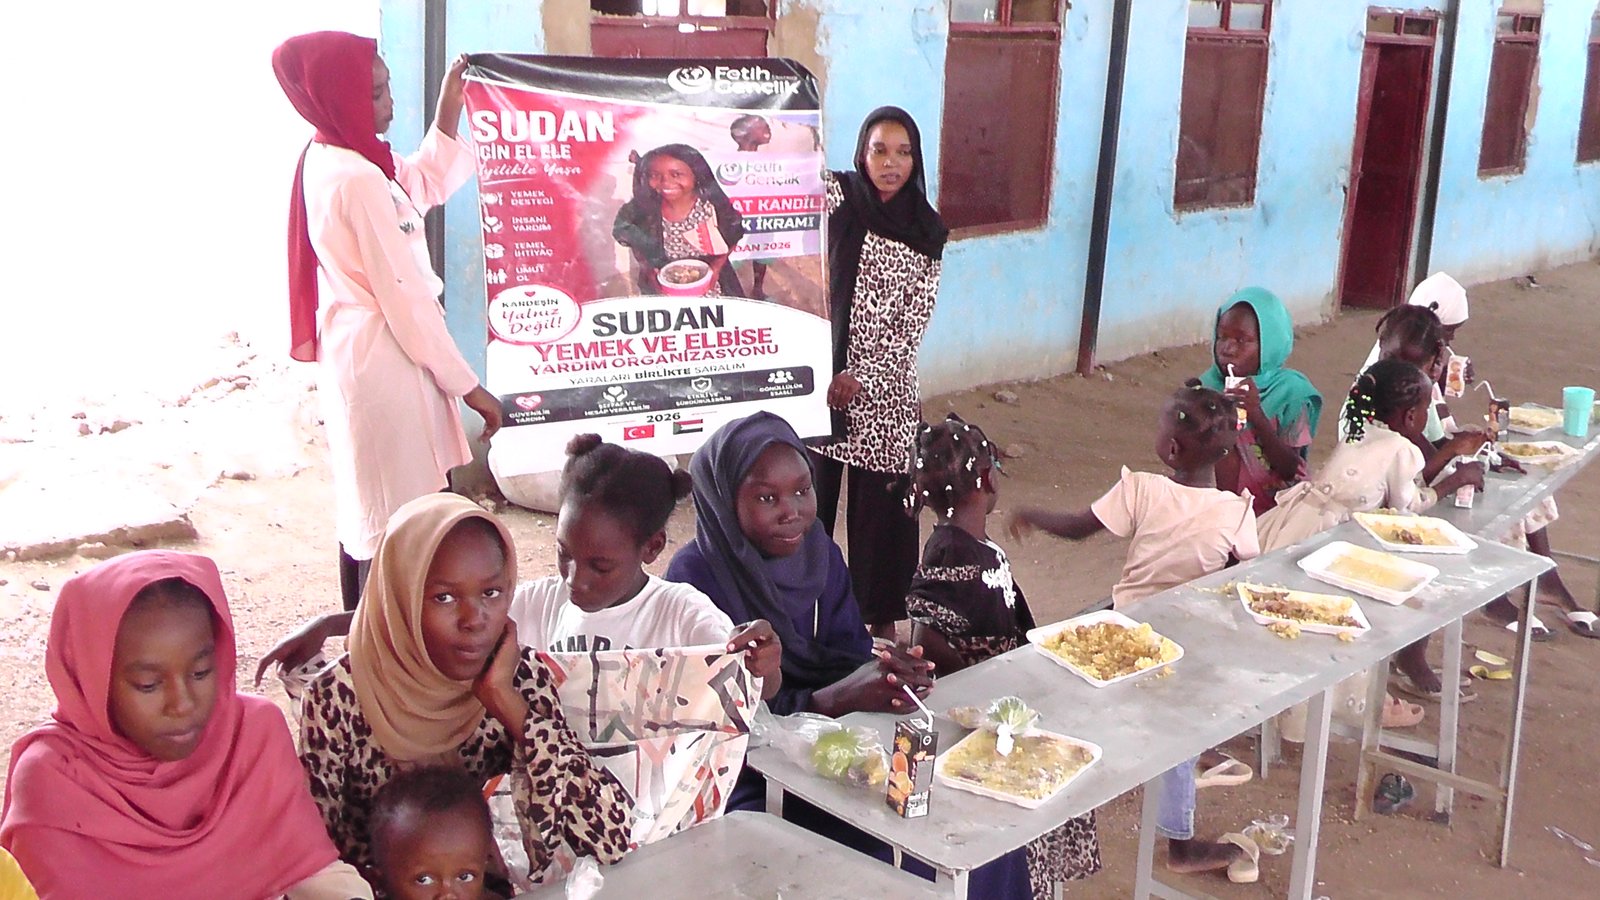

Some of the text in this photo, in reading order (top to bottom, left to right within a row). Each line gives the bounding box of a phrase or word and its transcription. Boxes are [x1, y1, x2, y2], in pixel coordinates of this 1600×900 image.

[714, 65, 771, 81] Fetih
[472, 110, 616, 143] SUDAN
[514, 144, 537, 160] EL
[540, 144, 572, 160] ELE
[511, 190, 545, 198] YEMEK
[732, 199, 753, 212] AT
[742, 218, 752, 231] K
[733, 241, 791, 252] DAN 2026
[592, 305, 725, 337] SUDAN
[533, 327, 773, 362] YEMEK VE ELBİSE
[529, 344, 779, 376] YARDIM ORGANİZASYONU
[635, 367, 691, 379] BİRLİKTE
[646, 412, 681, 423] 2026
